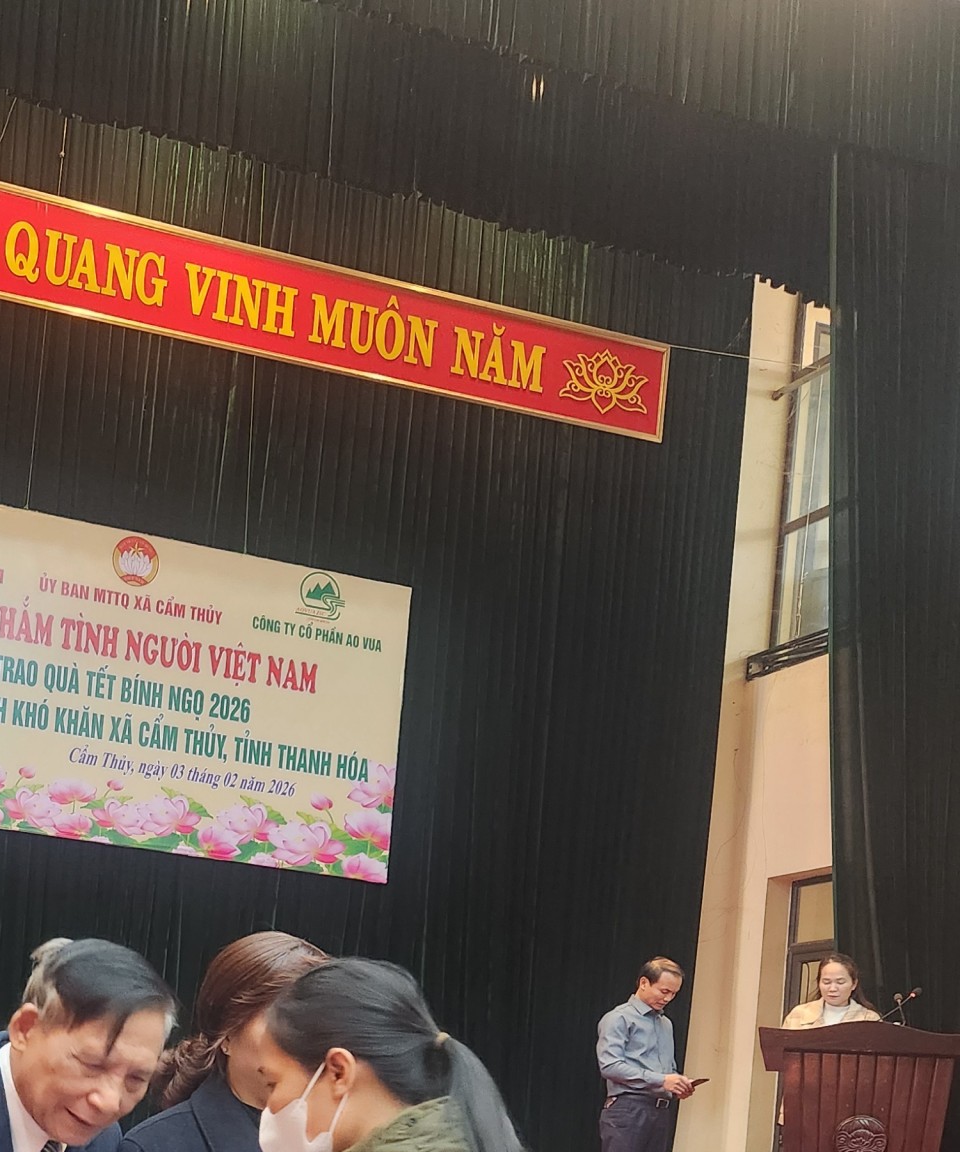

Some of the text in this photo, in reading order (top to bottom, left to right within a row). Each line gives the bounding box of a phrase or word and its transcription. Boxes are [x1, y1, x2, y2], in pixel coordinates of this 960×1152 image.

[5, 220, 169, 307] QUANG
[184, 262, 299, 338] VINH
[308, 295, 438, 369] MUÔN
[448, 323, 548, 395] NĂM
[39, 572, 223, 625] ỦY BAN MTTQ XÃ CẨM THỦY
[60, 612, 120, 659] TÌNH
[125, 629, 203, 674] NGƯỜI
[208, 642, 261, 687] VIỆT
[266, 655, 318, 694] NAM
[252, 615, 281, 633] CÔNG
[284, 622, 296, 636] TY
[346, 634, 360, 648] AO
[363, 637, 382, 652] VUA
[43, 662, 80, 695] QUÀ
[86, 664, 116, 700] TẾT
[120, 673, 164, 709] BÍNH
[168, 685, 204, 721] NGỌ
[209, 693, 251, 723] 2026
[11, 699, 49, 730] KHÓ
[54, 705, 105, 740] KHĂN
[110, 713, 133, 744] XÃ
[138, 713, 178, 752] CẨM
[184, 723, 227, 763] THỦY,
[234, 729, 272, 768] TỈNH
[277, 744, 332, 777] THANH
[336, 751, 369, 783] HÓA
[69, 745, 297, 797] Cẩm Thủy, ngày 03 tháng 02 năm 2026
